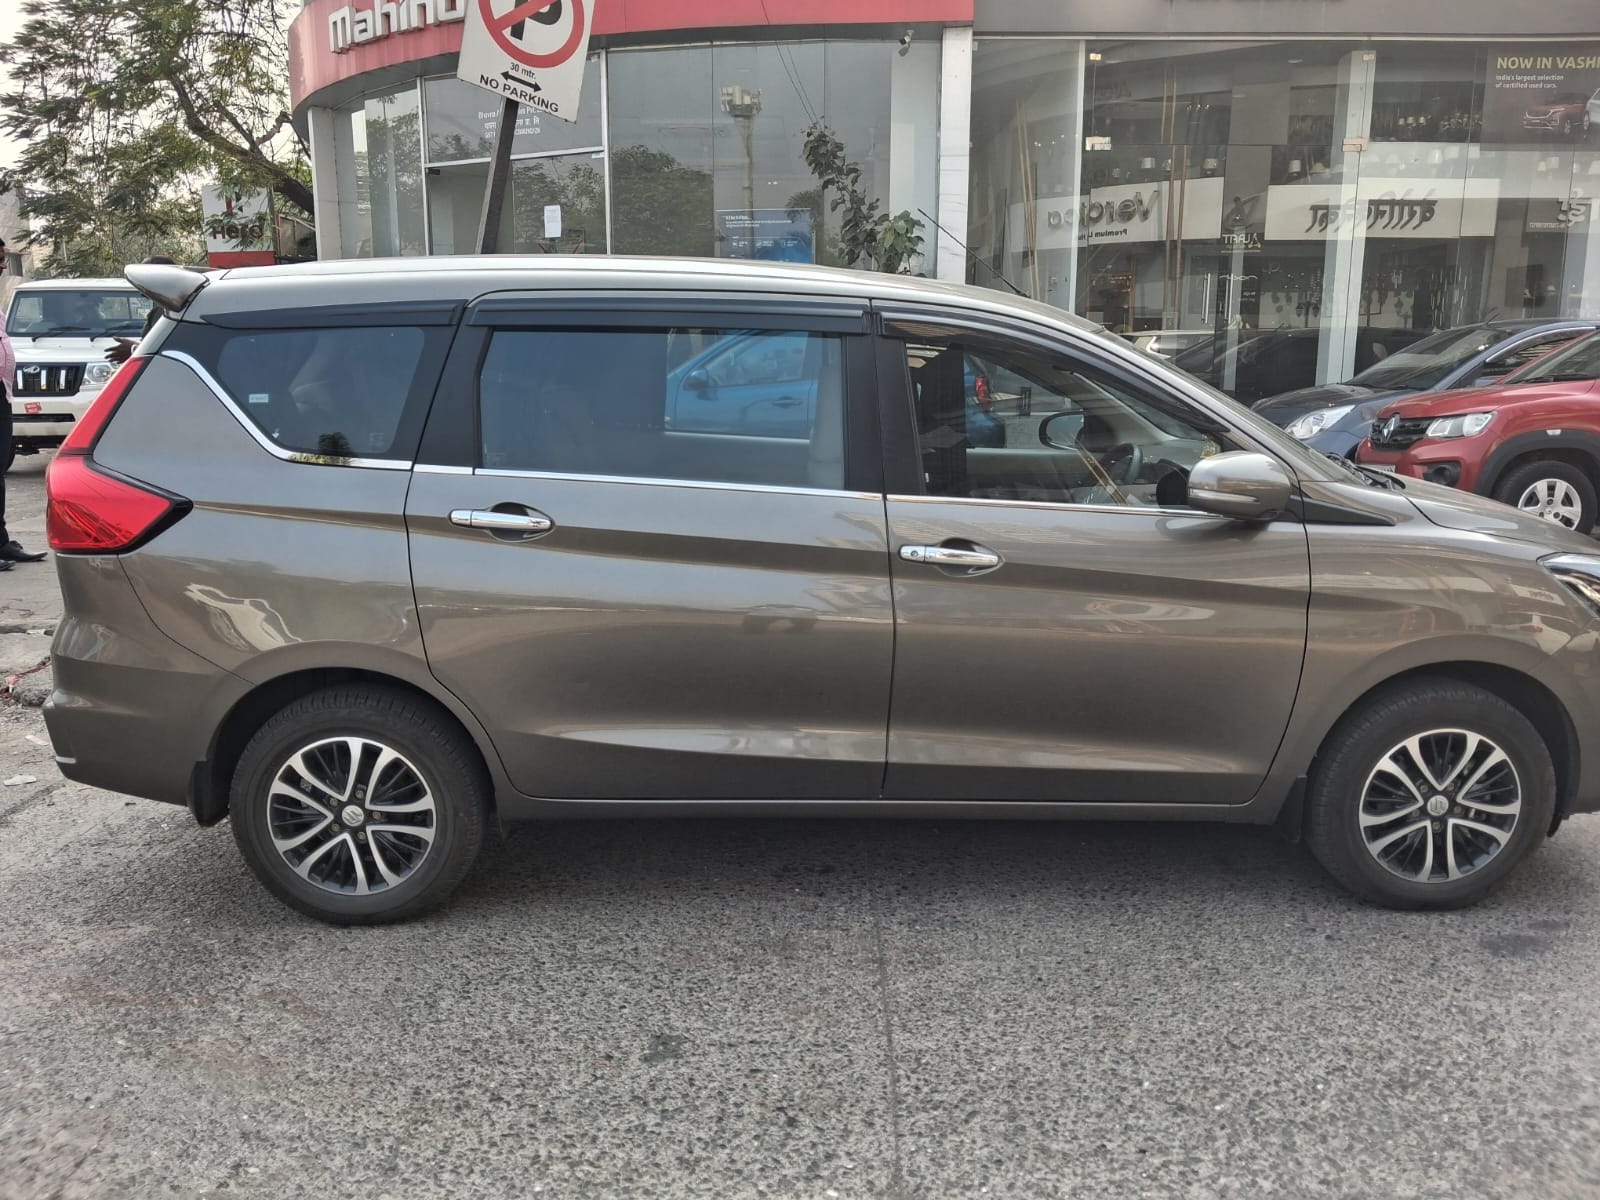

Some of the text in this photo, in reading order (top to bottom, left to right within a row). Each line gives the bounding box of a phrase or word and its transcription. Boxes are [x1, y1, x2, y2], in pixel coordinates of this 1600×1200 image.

[1497, 56, 1534, 69] NOW
[1536, 56, 1553, 69] IN
[510, 62, 536, 80] 30 mtr.
[1516, 74, 1537, 82] largest
[480, 74, 559, 113] NO PARKING
